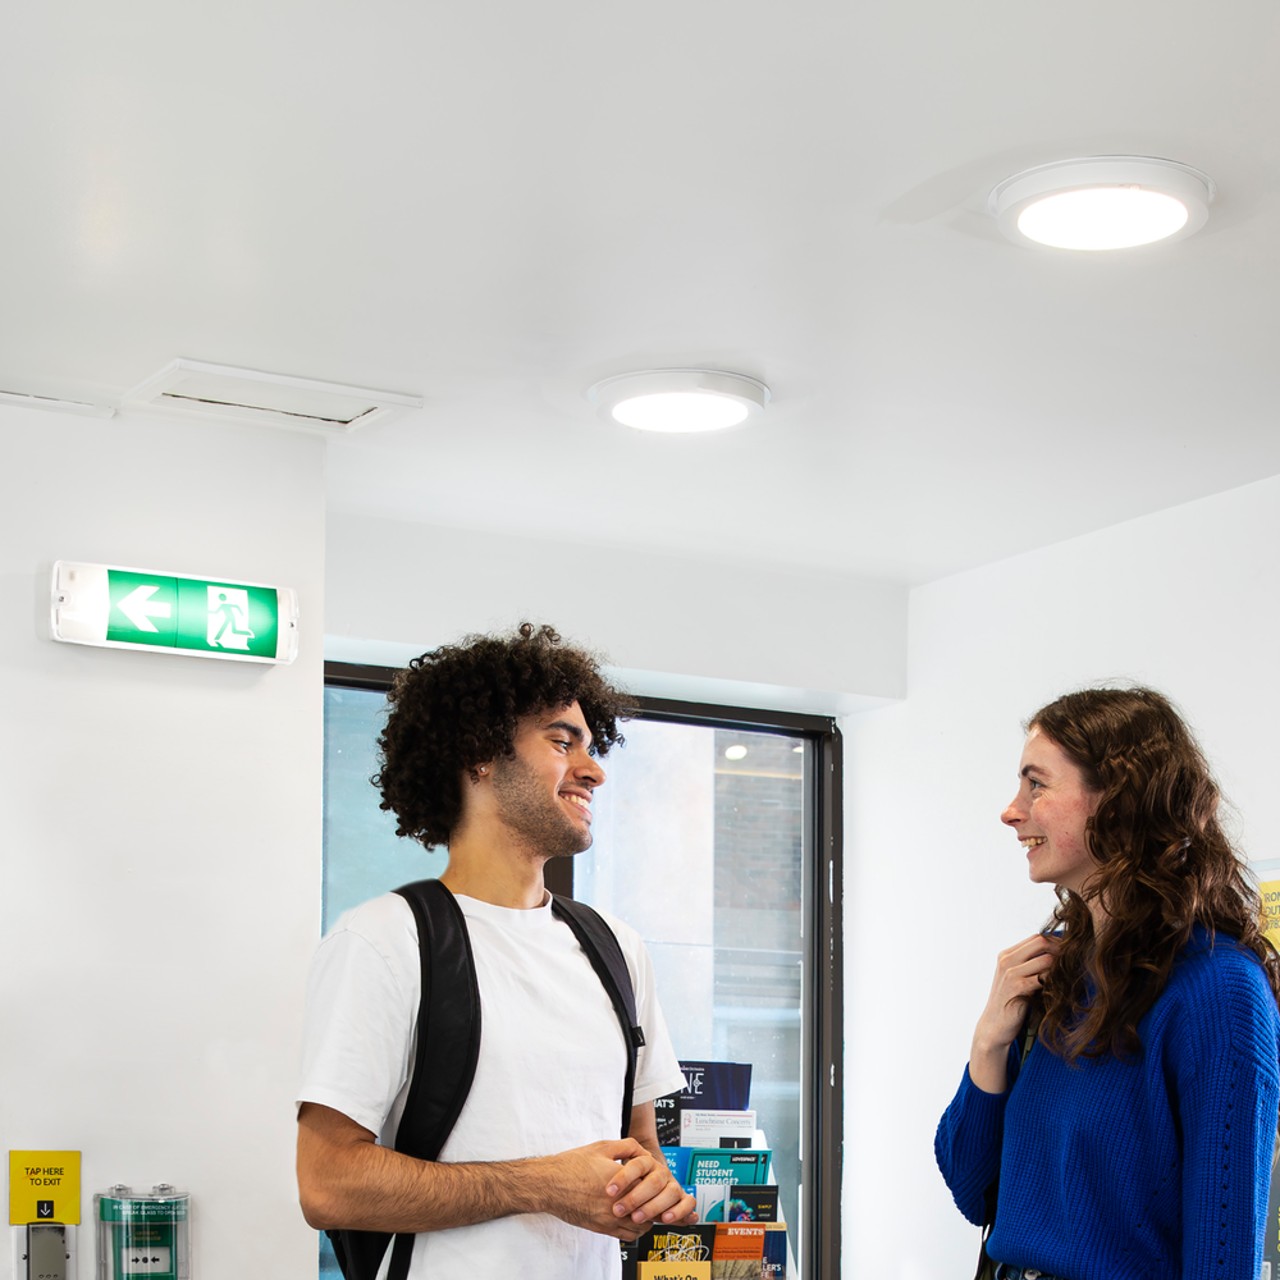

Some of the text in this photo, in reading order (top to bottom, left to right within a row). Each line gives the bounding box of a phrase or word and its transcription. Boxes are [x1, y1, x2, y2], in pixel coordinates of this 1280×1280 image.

[697, 1160, 720, 1168] NEED
[25, 1167, 64, 1175] TAP HERE
[696, 1169, 734, 1177] STUDENT
[43, 1178, 61, 1186] EXIT
